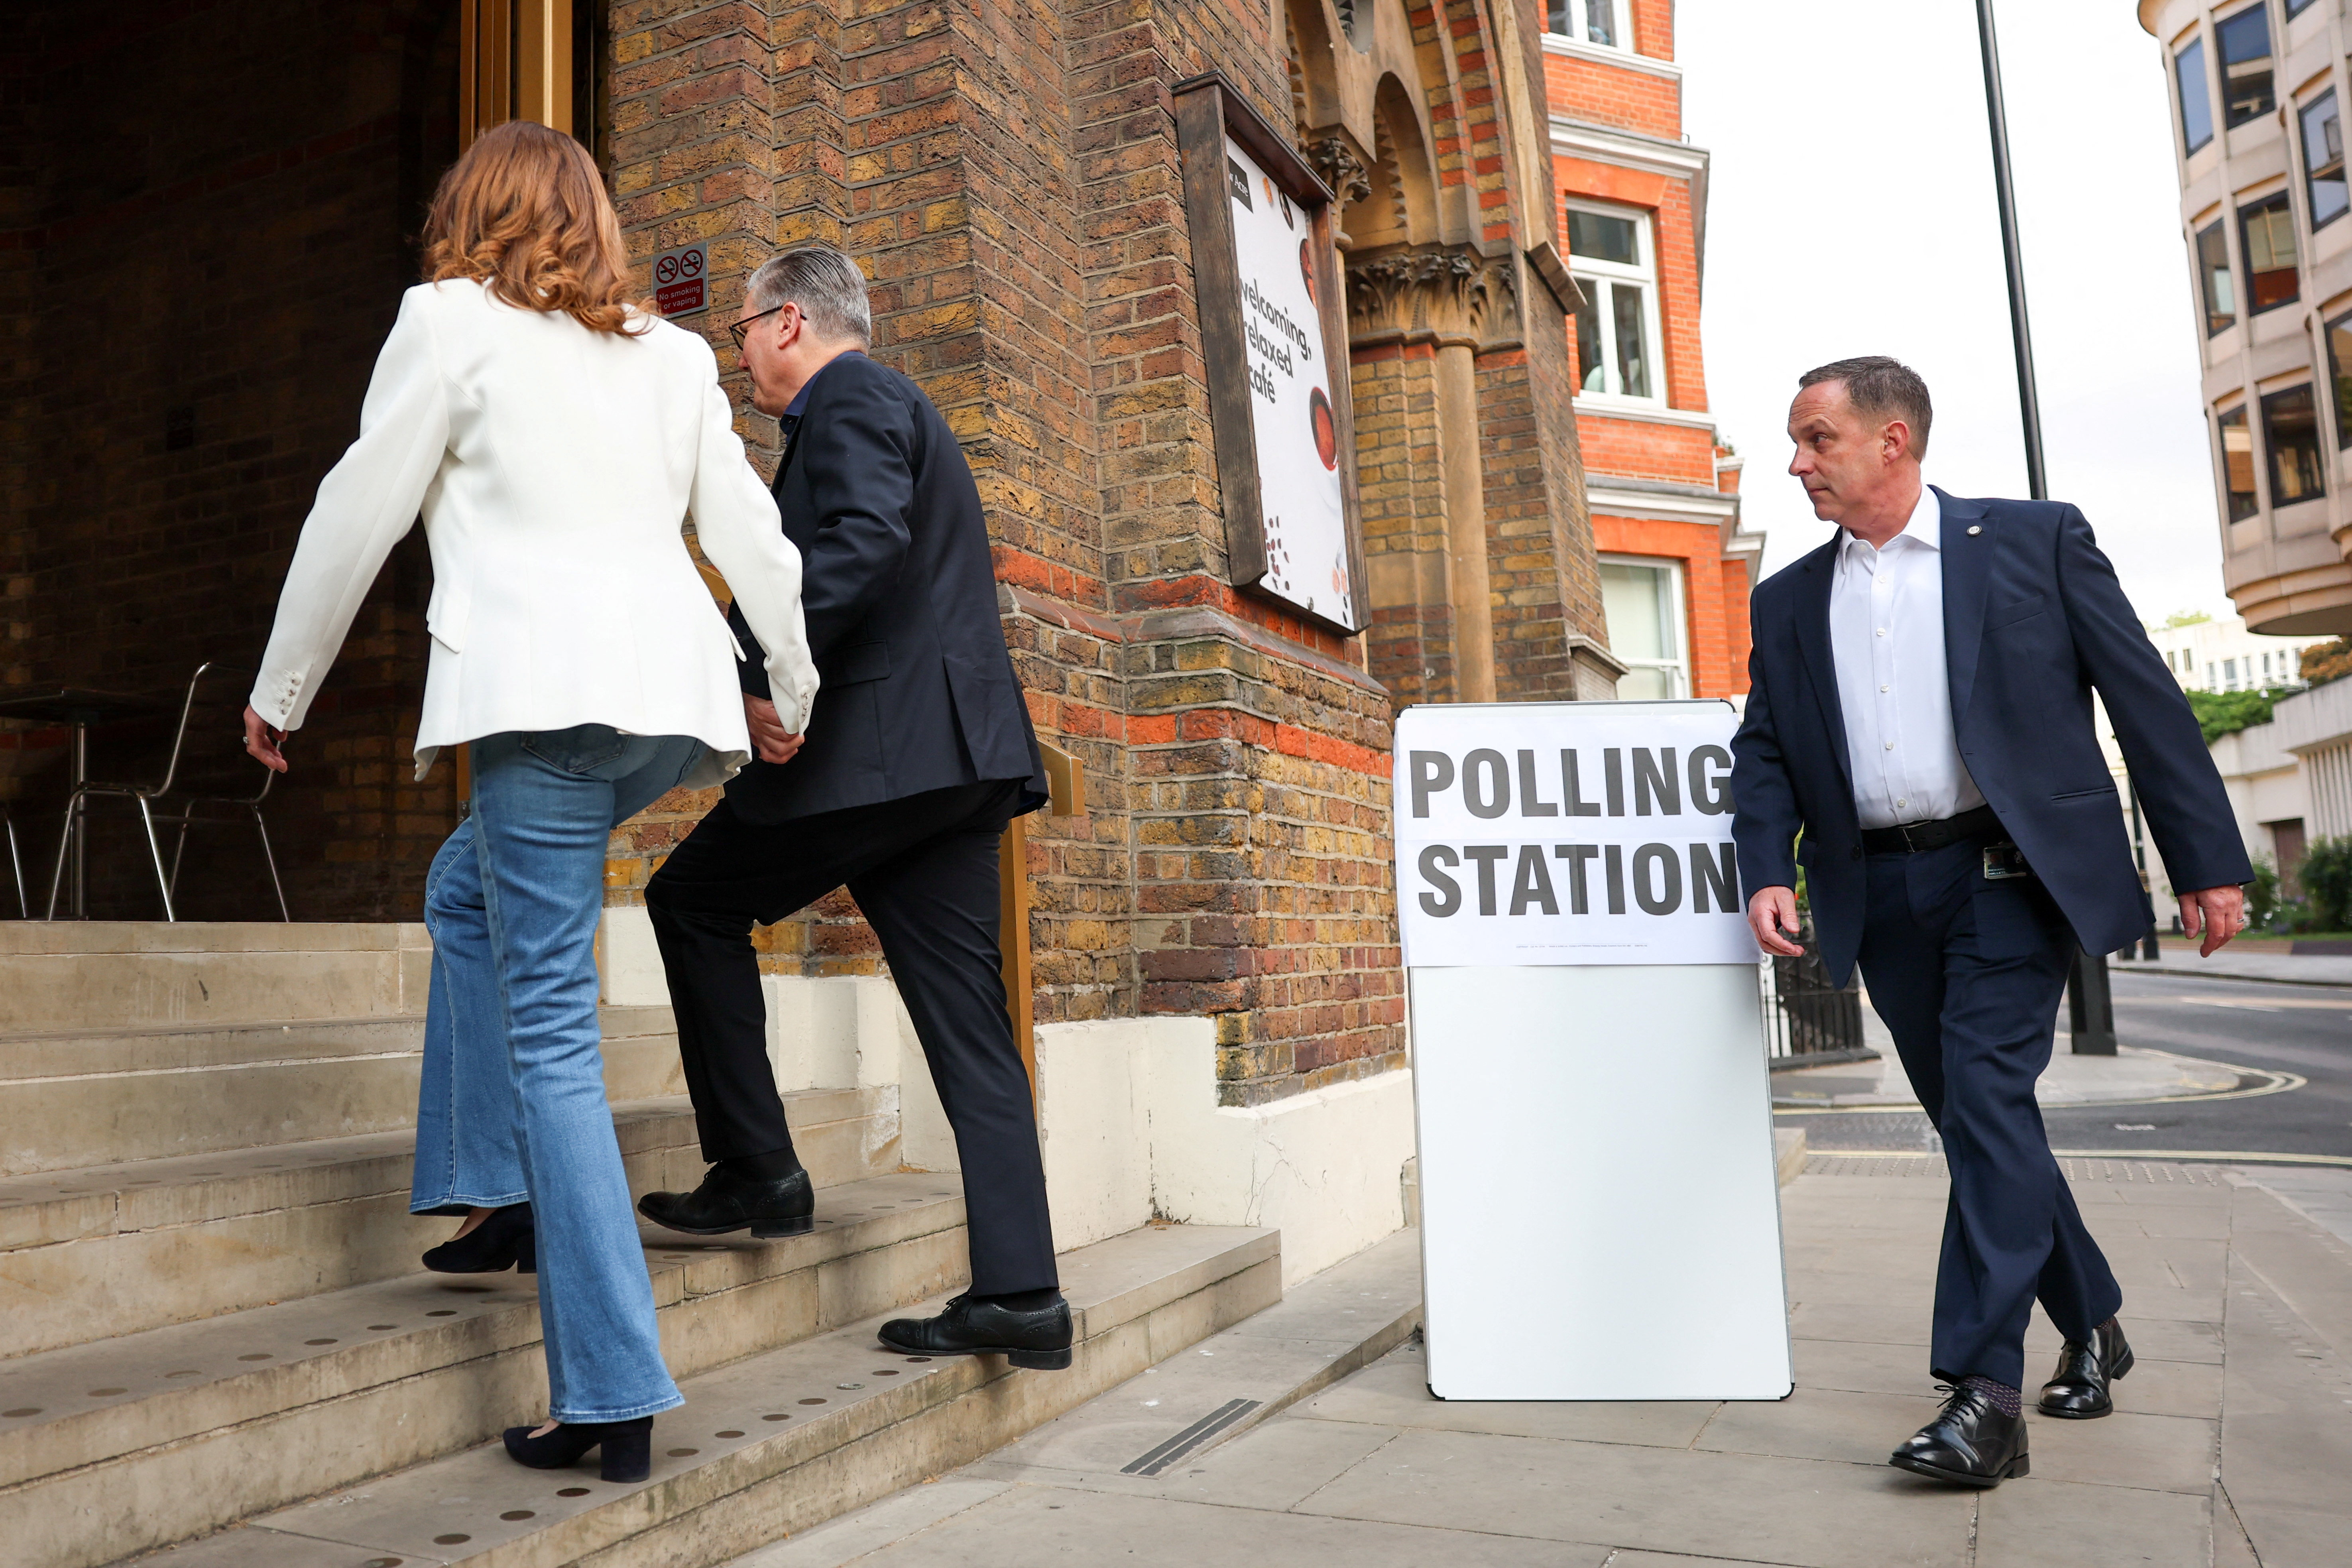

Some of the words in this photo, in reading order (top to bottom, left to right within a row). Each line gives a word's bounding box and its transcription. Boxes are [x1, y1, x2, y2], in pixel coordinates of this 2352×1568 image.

[1235, 174, 1249, 197] Acre
[671, 286, 700, 298] smoking
[673, 297, 696, 307] vaping
[1248, 362, 1275, 403] café
[1410, 744, 1737, 819] POLLING
[1418, 842, 1740, 918] STATION
